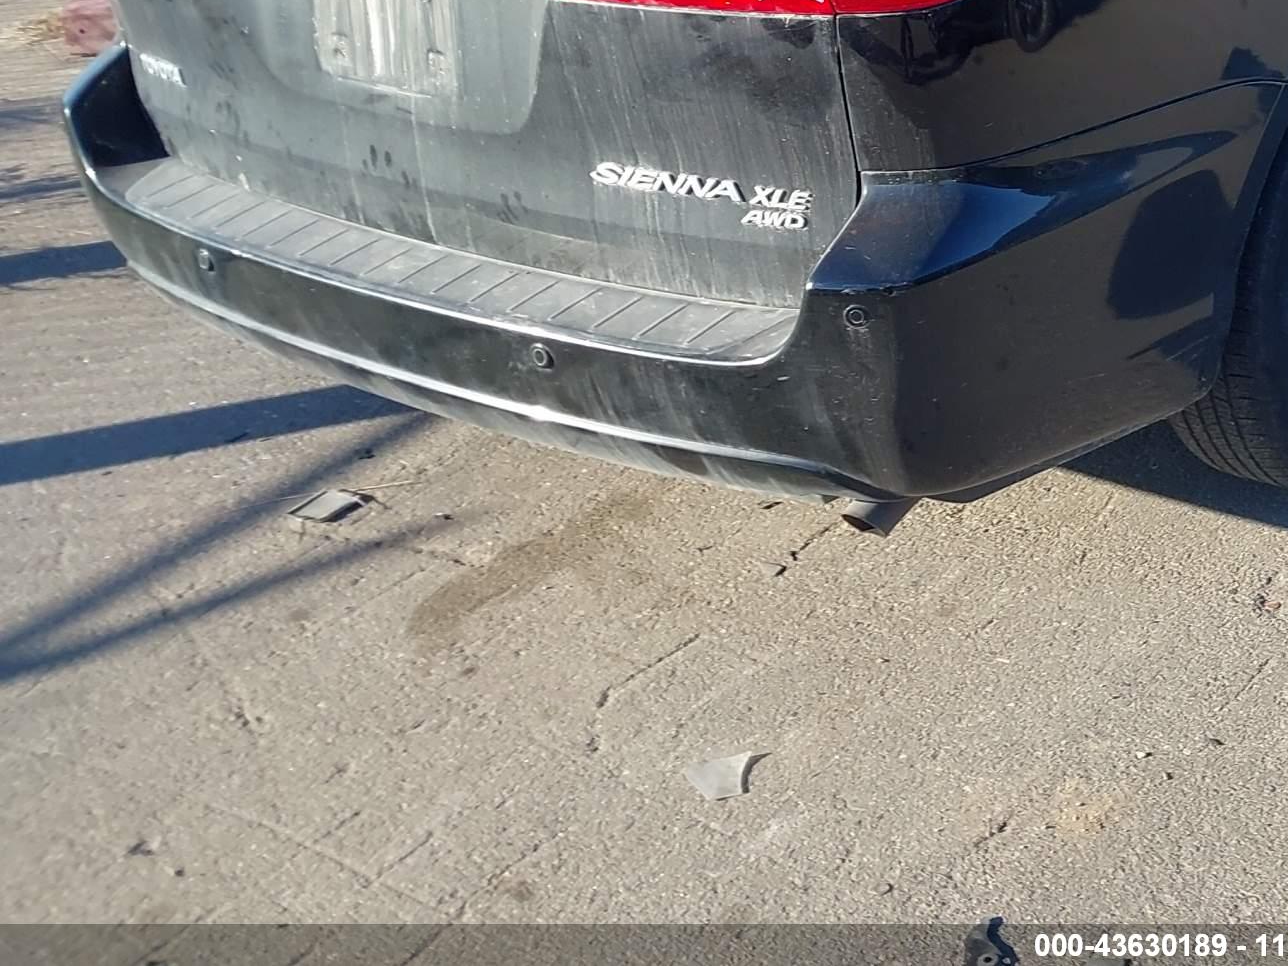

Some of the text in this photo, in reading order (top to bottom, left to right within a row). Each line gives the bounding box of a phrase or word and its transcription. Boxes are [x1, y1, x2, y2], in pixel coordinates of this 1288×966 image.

[589, 161, 813, 211] SIENNA XLE
[741, 209, 808, 230] AWD
